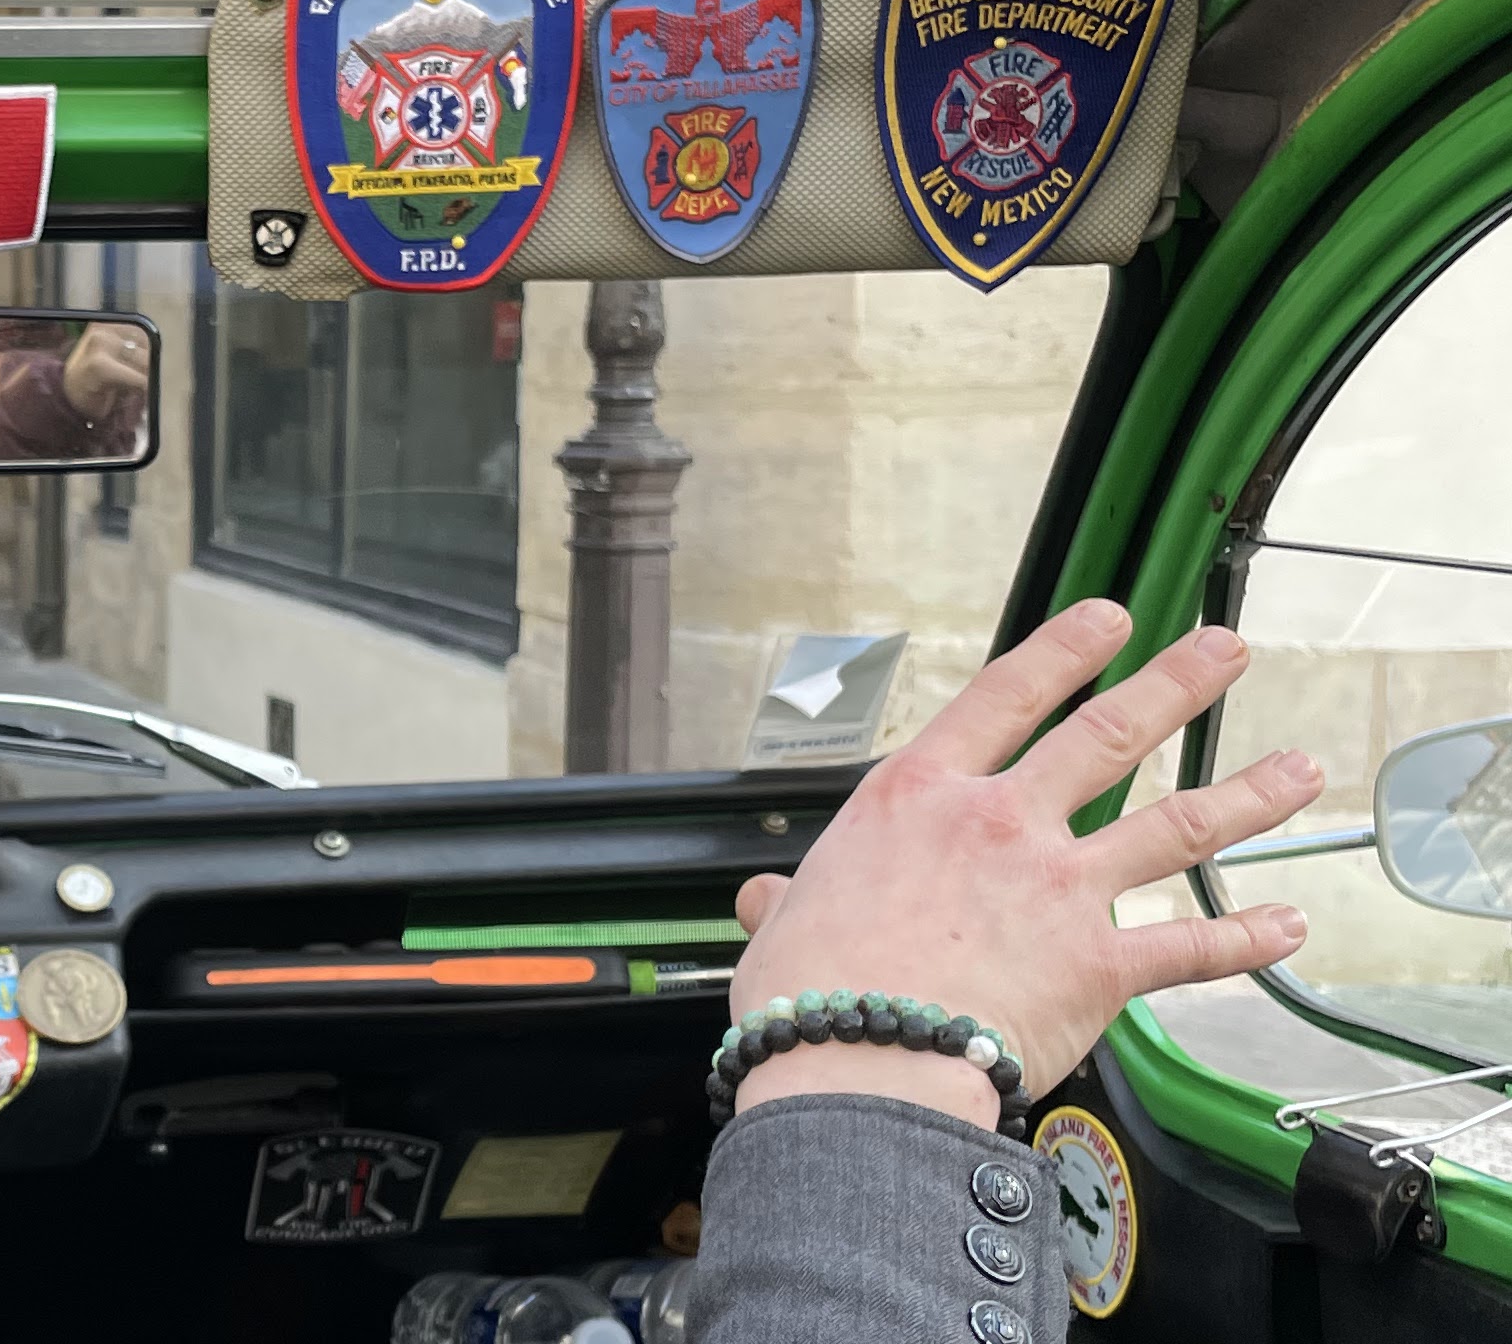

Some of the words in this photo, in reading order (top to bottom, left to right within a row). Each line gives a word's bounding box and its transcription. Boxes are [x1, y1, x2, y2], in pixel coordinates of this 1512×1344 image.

[915, 7, 969, 49] FIRE
[977, 3, 1130, 53] DEPARTMENT
[419, 60, 453, 76] FIRE
[988, 54, 1043, 80] FIRE
[608, 86, 649, 106] CITY
[652, 83, 679, 103] OF
[682, 70, 800, 99] TALLAHASSEE
[681, 112, 732, 136] FIRE
[964, 153, 1035, 179] RESCUE
[674, 188, 730, 216] DEPT.
[919, 165, 974, 220] NEW
[978, 165, 1074, 228] MEXICO
[399, 248, 467, 273] F.P.D.
[1112, 1200, 1129, 1283] RESCUE
